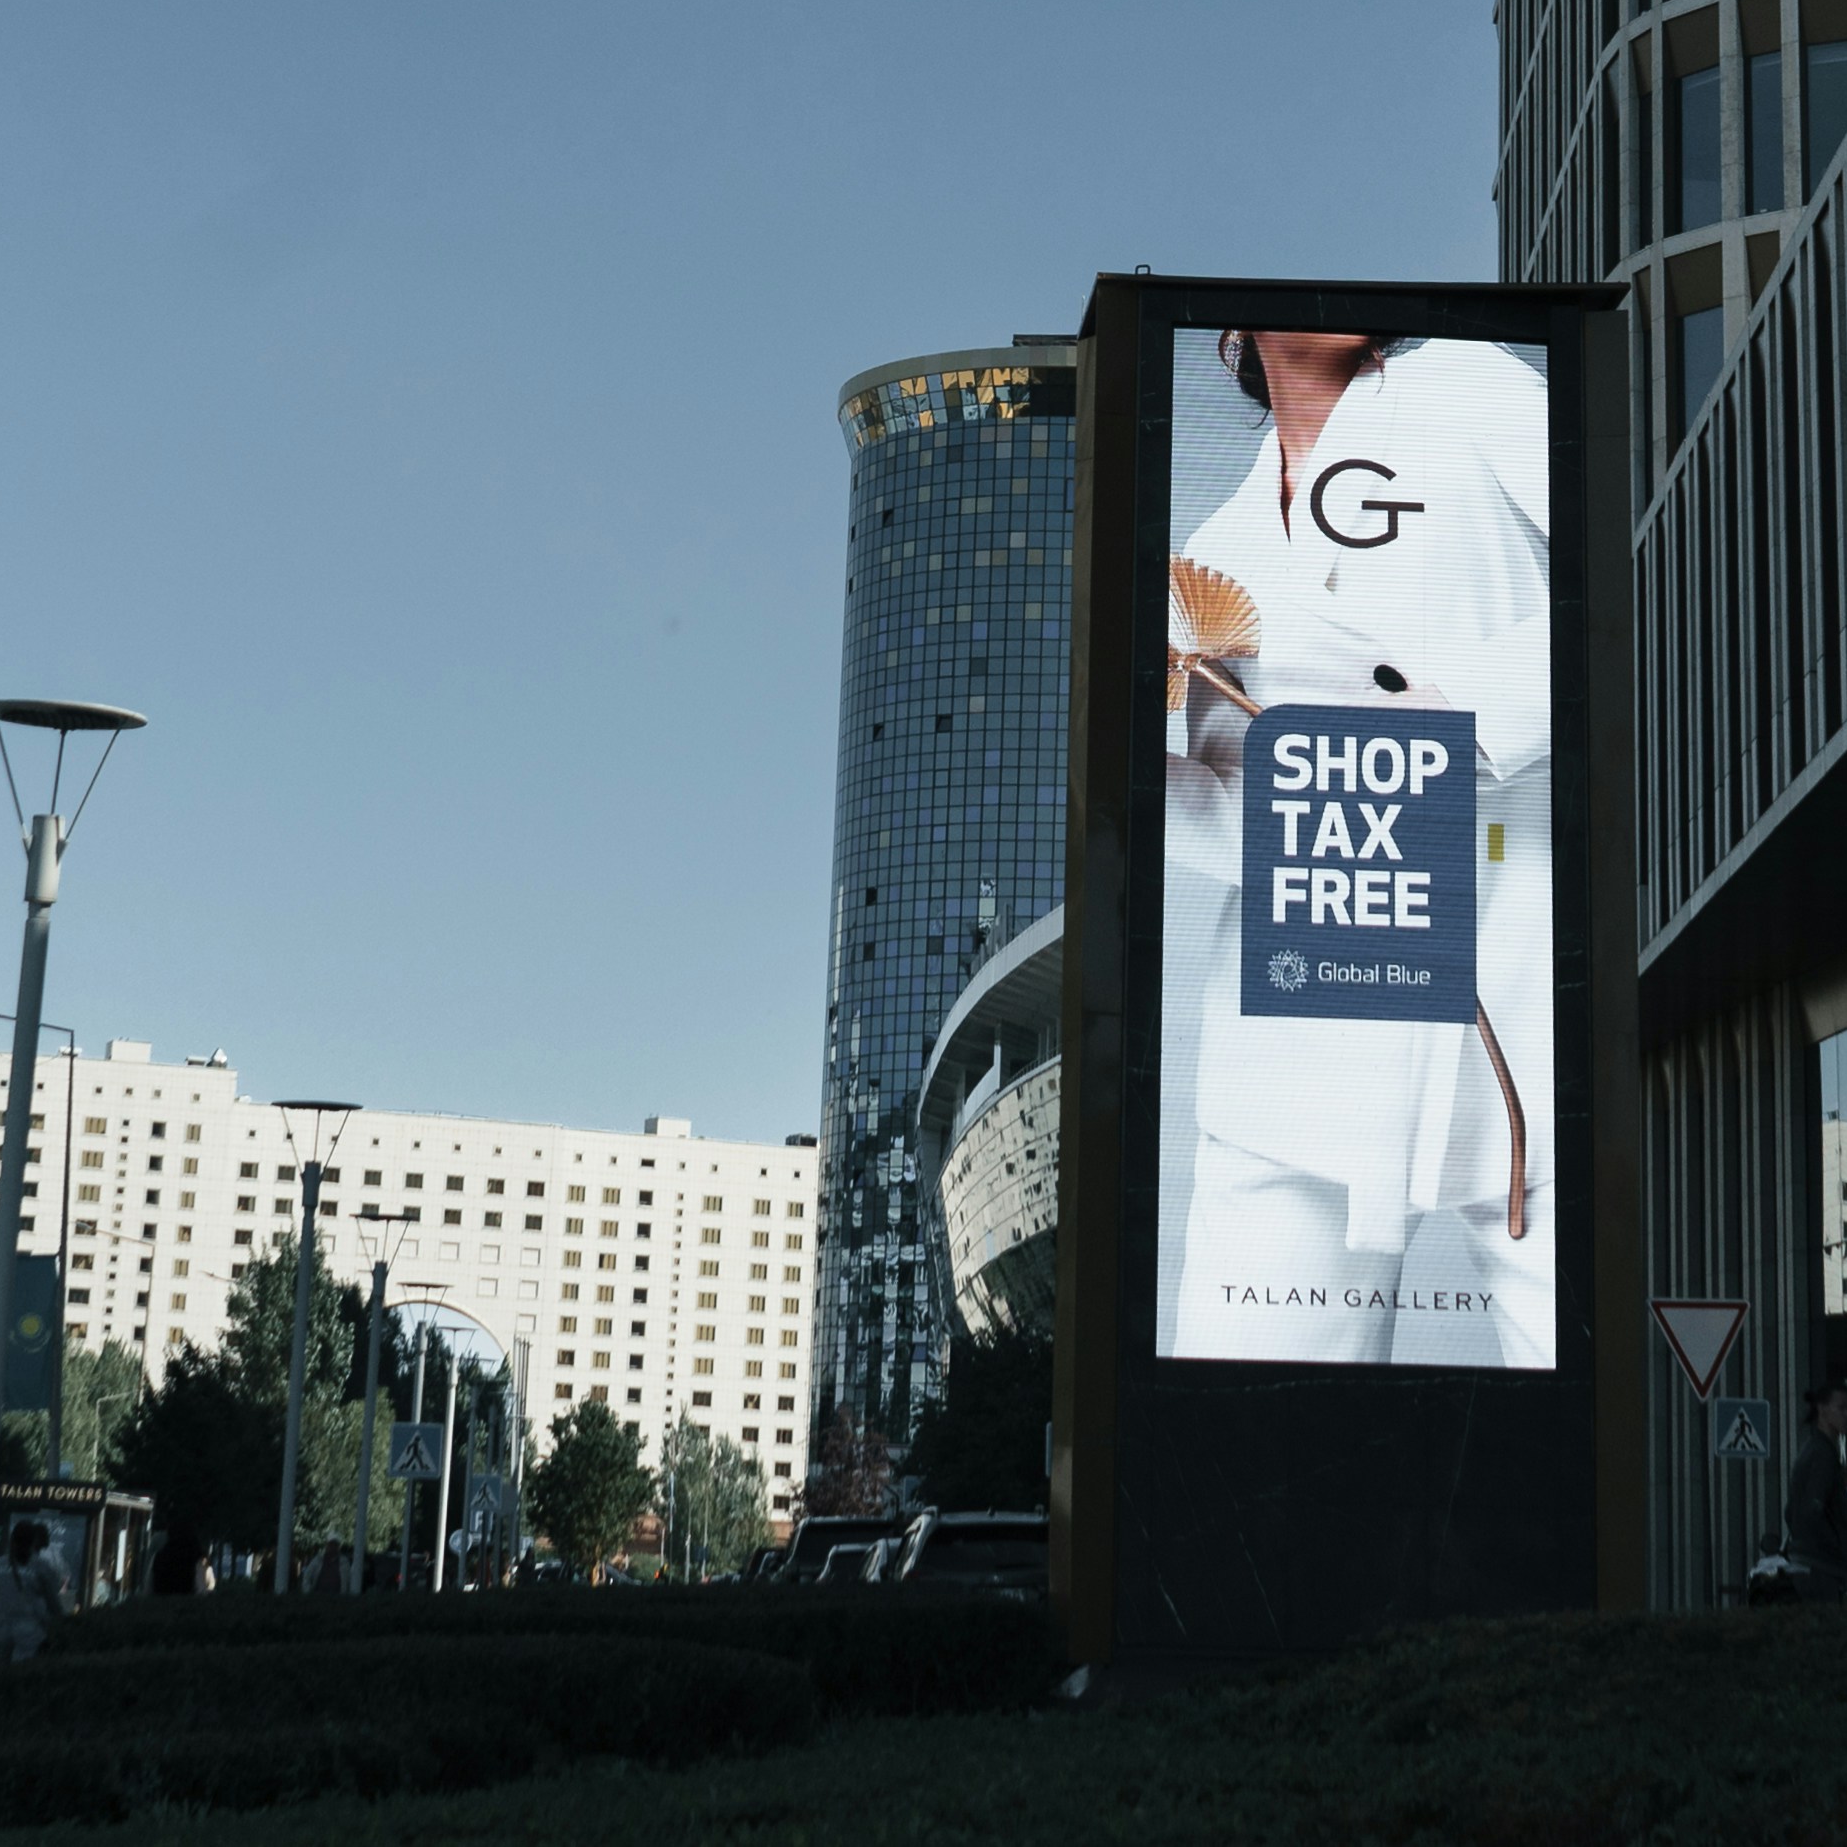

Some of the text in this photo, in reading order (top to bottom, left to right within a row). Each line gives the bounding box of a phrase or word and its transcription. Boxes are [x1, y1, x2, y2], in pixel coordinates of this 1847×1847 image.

[1272, 733, 1450, 795] SHOP
[1271, 799, 1404, 861] TAX
[1272, 866, 1431, 929] FREE
[1318, 961, 1431, 985] Global Blue
[1221, 1285, 1494, 1312] TALAN GALLERY
[0, 1483, 43, 1499] TALAN
